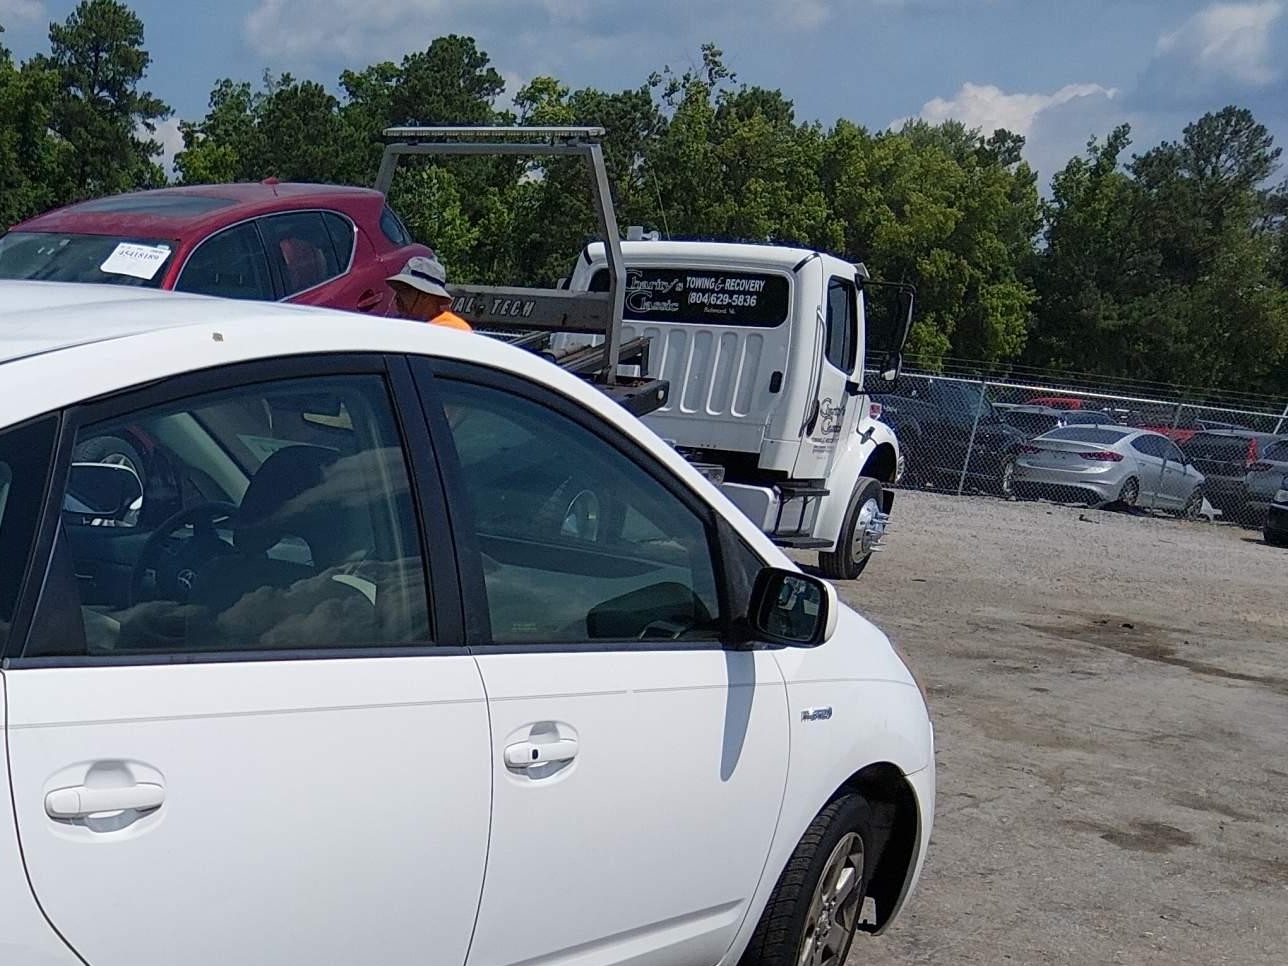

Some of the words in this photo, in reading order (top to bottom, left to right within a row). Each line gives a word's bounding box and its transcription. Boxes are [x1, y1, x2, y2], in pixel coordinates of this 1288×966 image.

[686, 276, 715, 289] TOWING
[714, 276, 726, 292] &
[724, 278, 765, 292] RECOVERY
[490, 299, 535, 317] TECH
